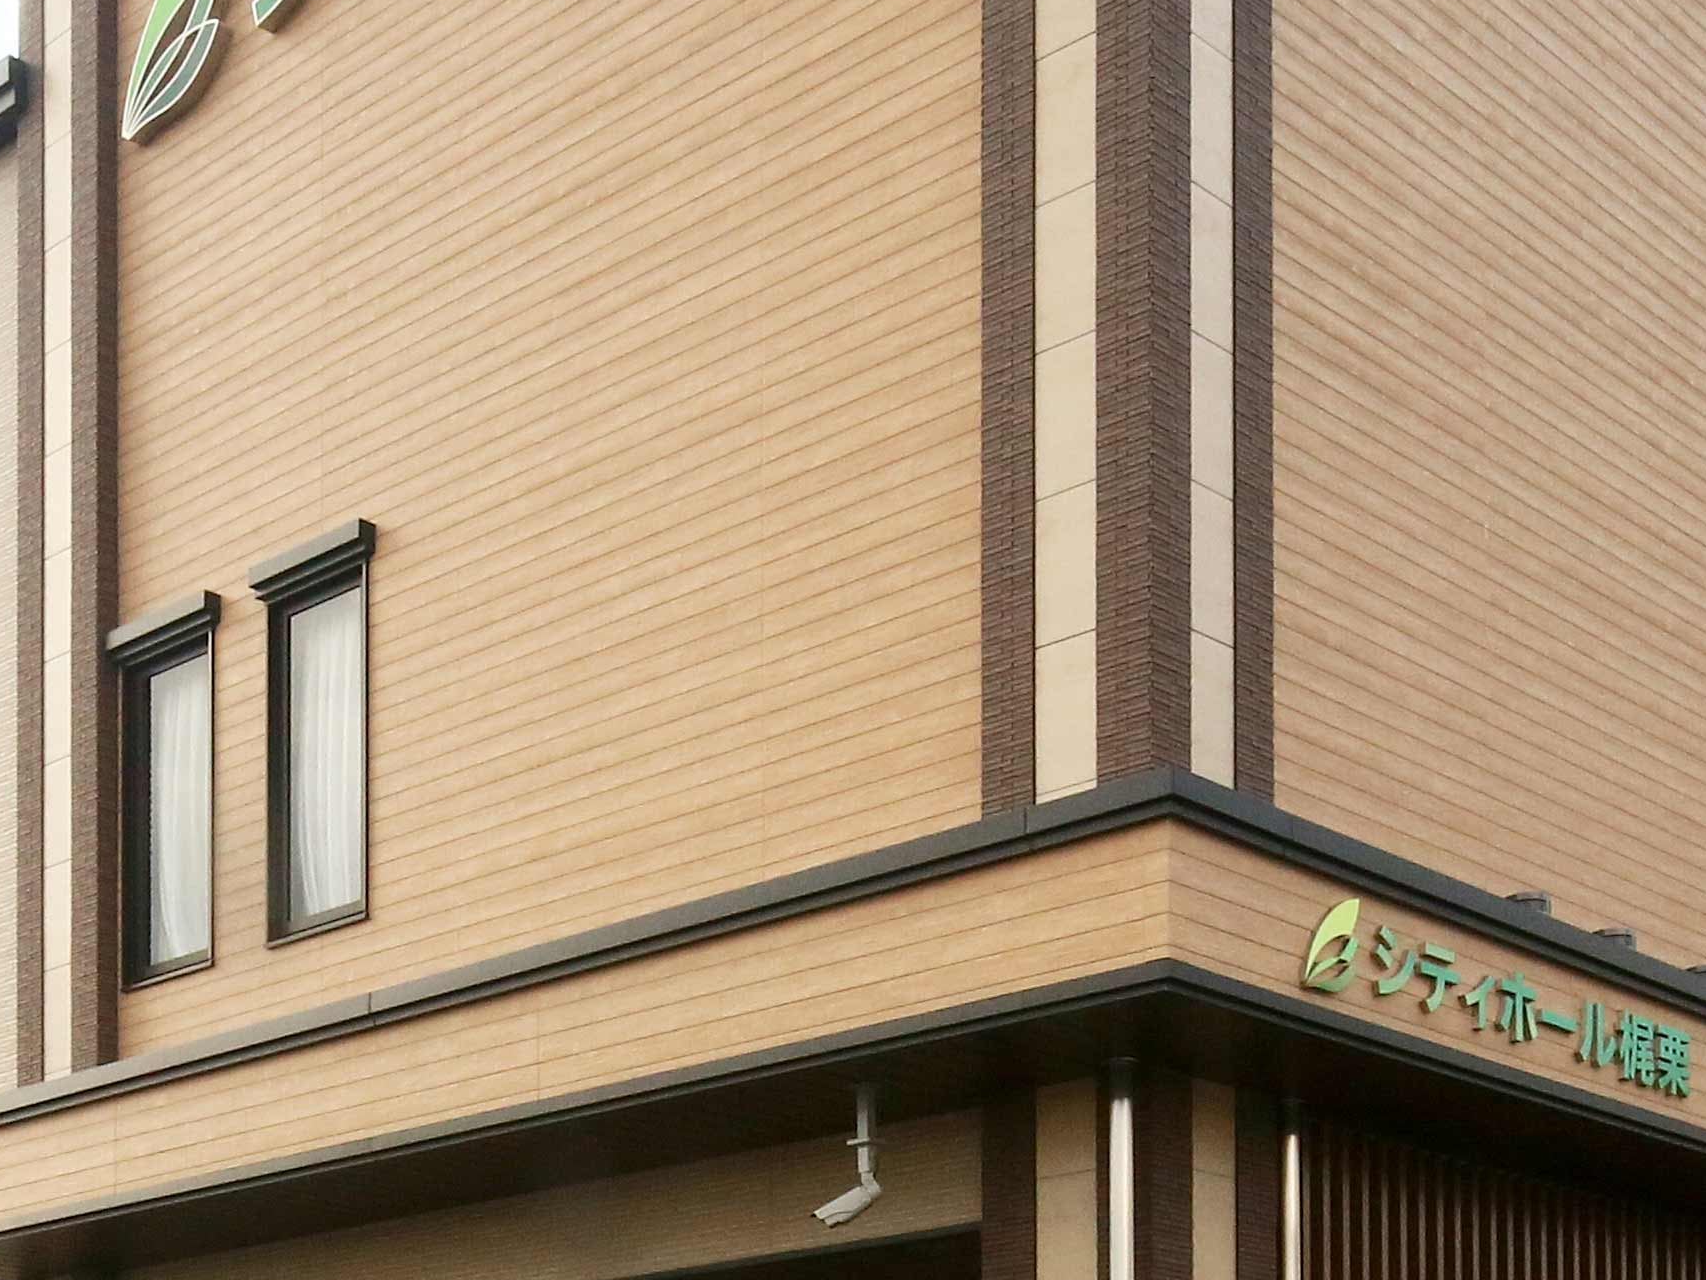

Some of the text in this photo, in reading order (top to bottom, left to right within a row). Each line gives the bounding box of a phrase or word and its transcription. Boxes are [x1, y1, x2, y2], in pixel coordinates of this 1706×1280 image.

[1371, 924, 1691, 1098] シティホール梶栗
